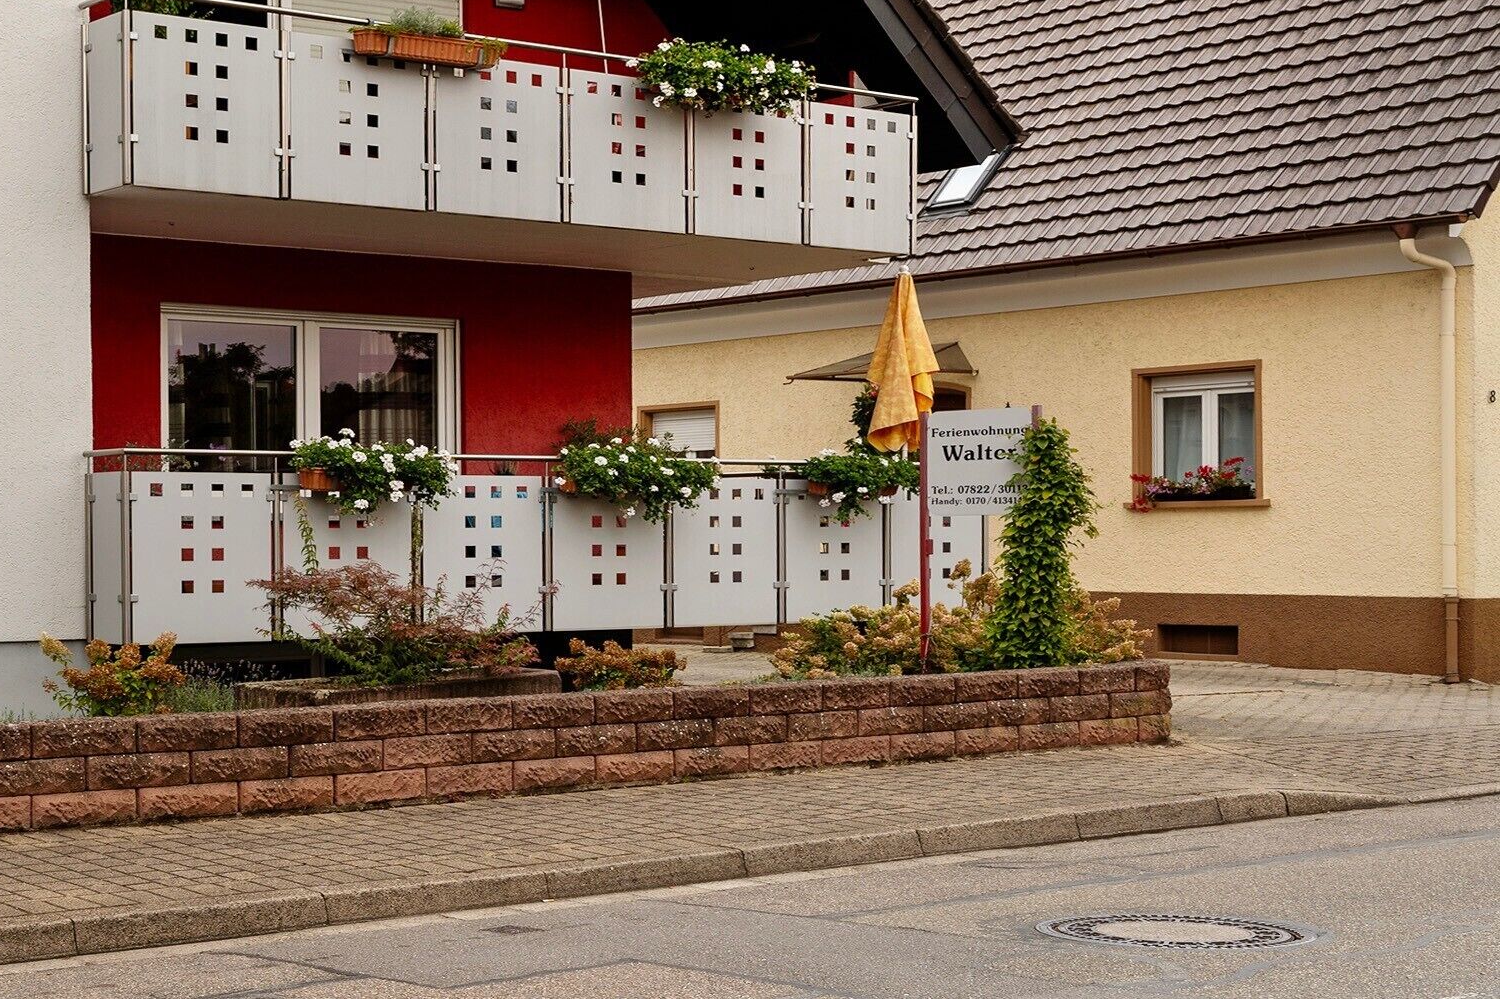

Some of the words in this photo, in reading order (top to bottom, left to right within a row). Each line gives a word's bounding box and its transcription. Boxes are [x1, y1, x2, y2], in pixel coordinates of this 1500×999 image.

[1489, 390, 1496, 403] 8
[931, 426, 1028, 438] Ferienwohnung
[942, 444, 1017, 462] Walter
[931, 486, 953, 494] Tel.:
[931, 497, 962, 506] Handy:
